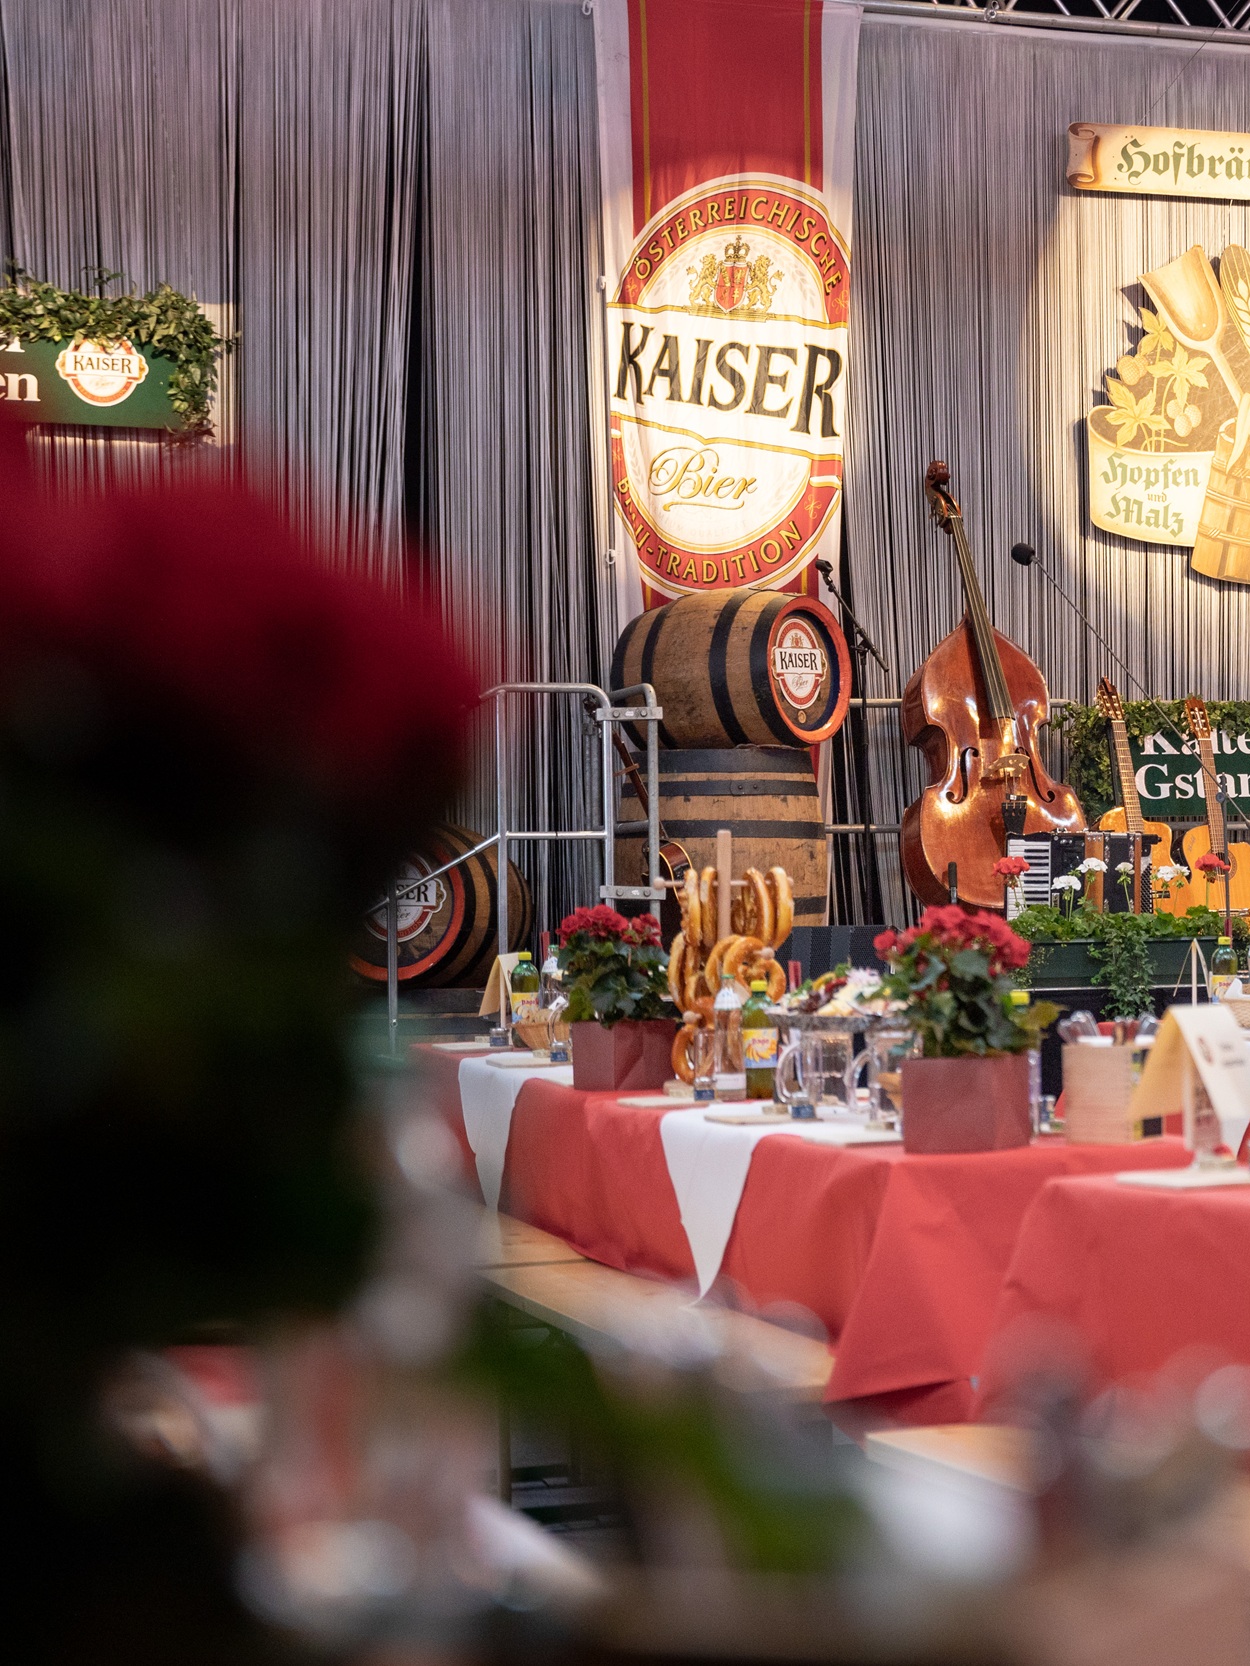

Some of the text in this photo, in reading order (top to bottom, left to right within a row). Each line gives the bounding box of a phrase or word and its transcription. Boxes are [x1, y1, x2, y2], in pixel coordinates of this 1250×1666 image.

[634, 196, 843, 295] ÖSTERREICHISCHE
[73, 355, 132, 374] KAISER
[613, 321, 843, 438] KAISER
[648, 446, 758, 501] Bier
[1100, 452, 1201, 491] Hopfen
[1103, 491, 1185, 538] Malz
[1147, 491, 1168, 503] und
[617, 477, 803, 583] BU-TRADITION
[779, 651, 818, 671] KAISER
